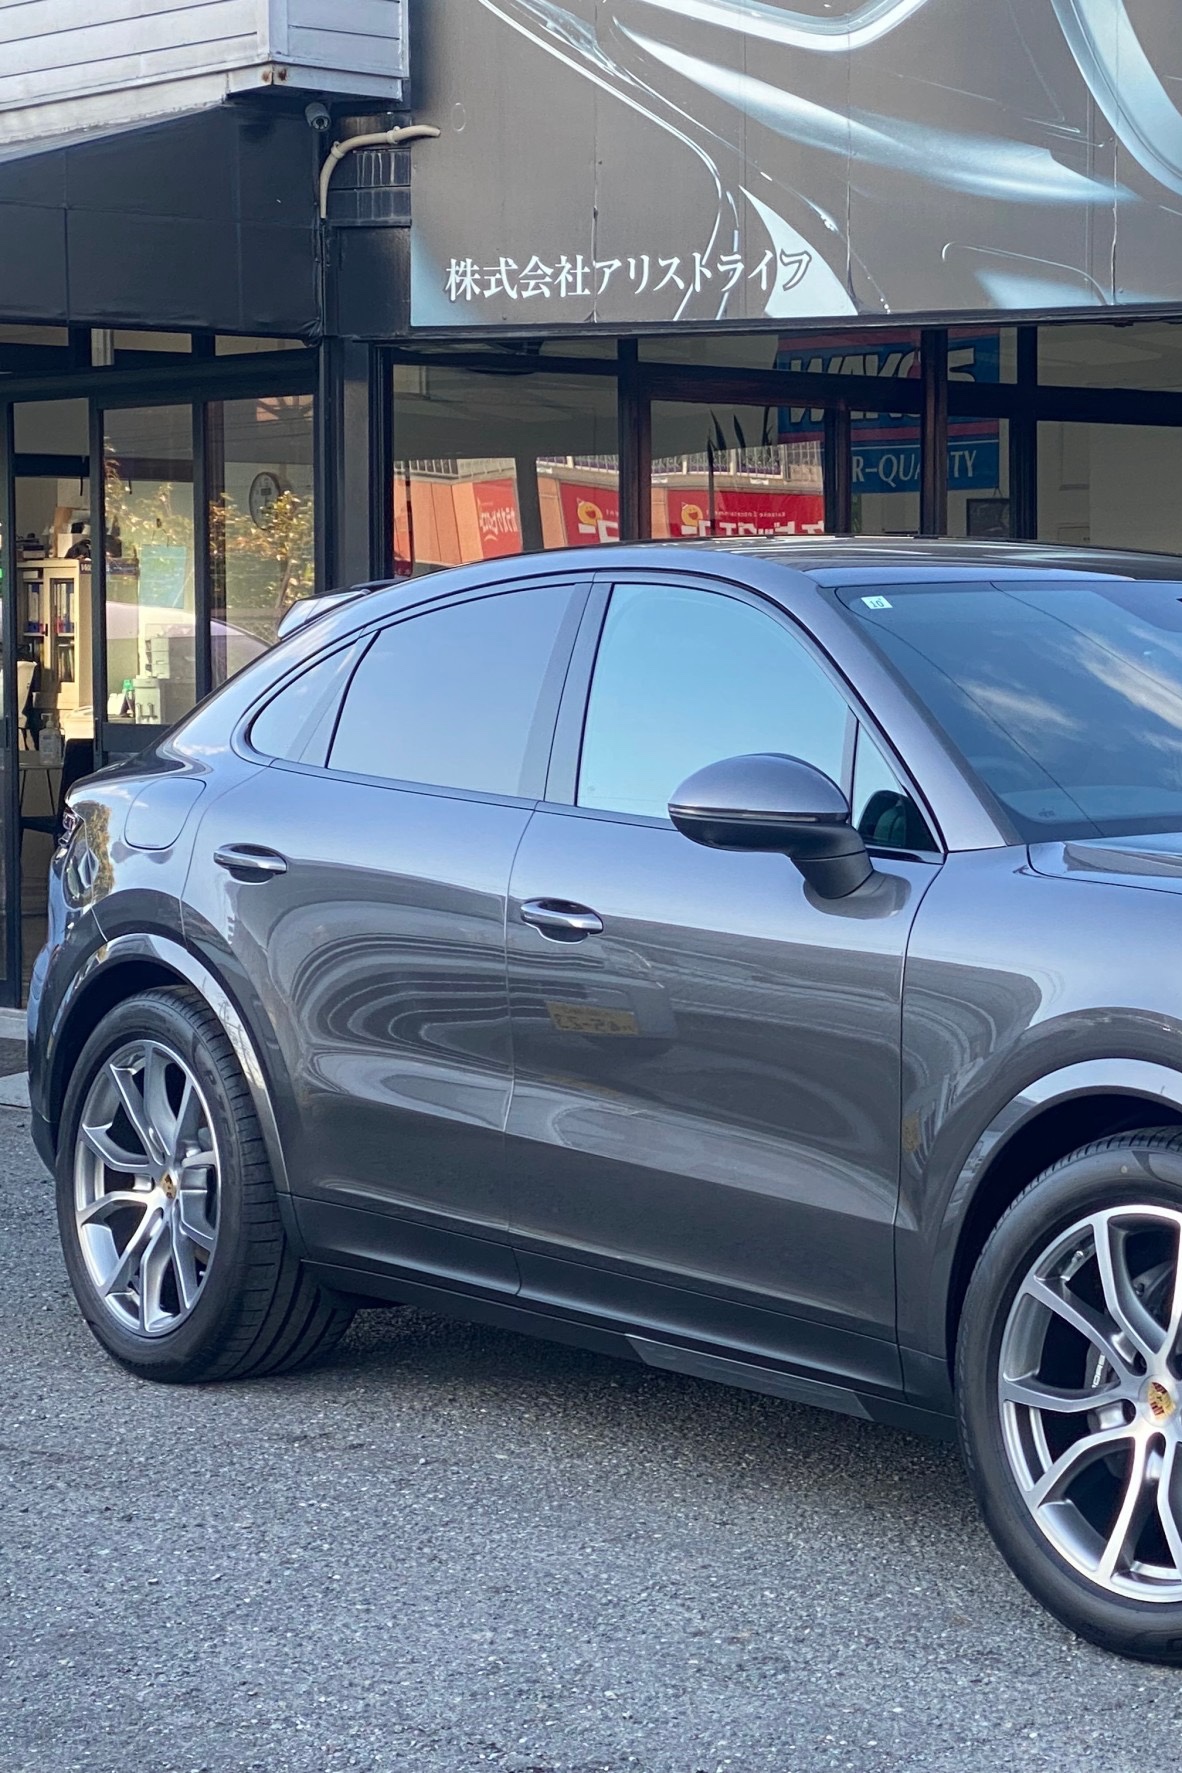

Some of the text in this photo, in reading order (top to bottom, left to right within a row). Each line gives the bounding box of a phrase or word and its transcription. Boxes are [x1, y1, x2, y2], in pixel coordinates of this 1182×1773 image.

[445, 248, 812, 302] 株式会社アリストライフ
